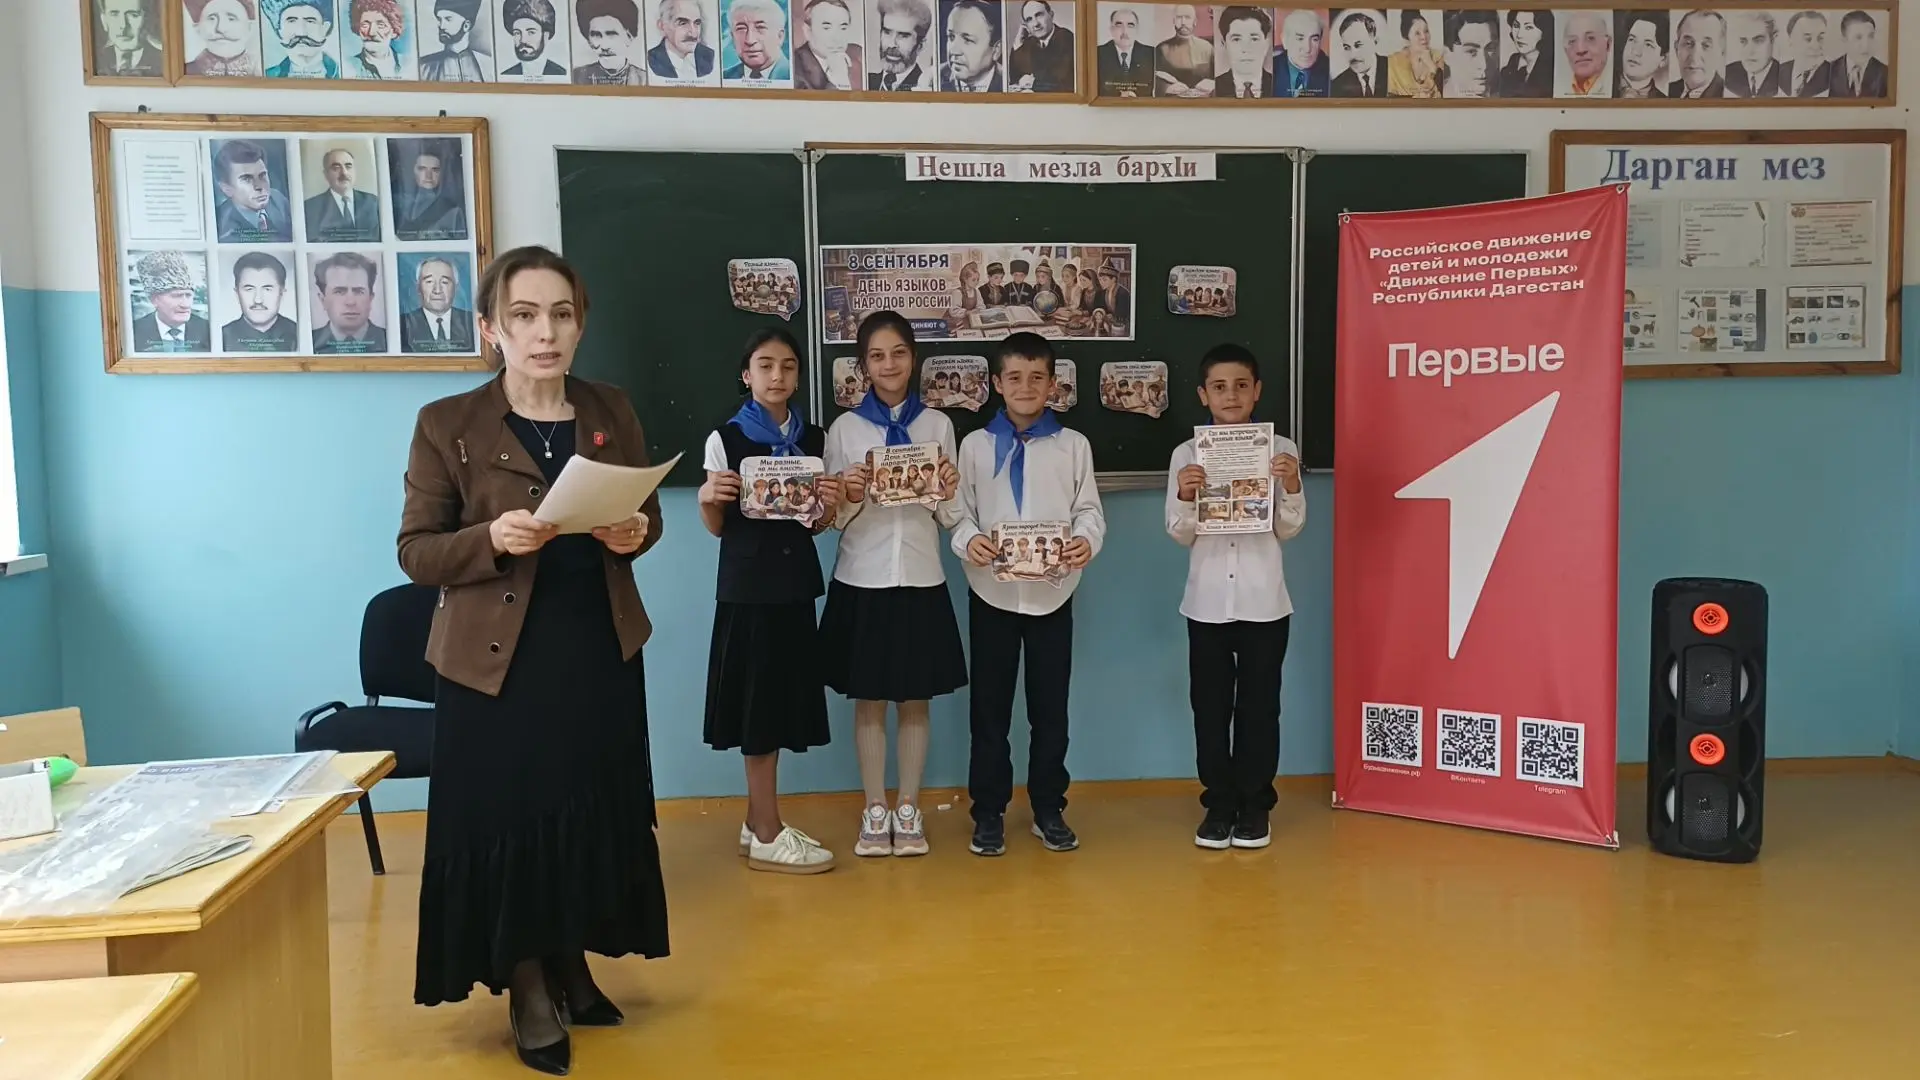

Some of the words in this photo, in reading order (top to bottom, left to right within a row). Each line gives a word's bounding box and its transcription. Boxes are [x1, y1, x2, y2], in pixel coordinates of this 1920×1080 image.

[916, 155, 1006, 178] Нешла
[1029, 159, 1102, 178] мезла
[1601, 149, 1737, 189] Дарган
[1763, 156, 1826, 181] мез
[1369, 240, 1484, 259] Российское
[1487, 229, 1592, 250] движение
[849, 255, 858, 269] 8
[863, 254, 949, 269] СЕНТЯБРЯ
[1388, 257, 1443, 273] детей
[1448, 258, 1459, 268] и
[1463, 247, 1569, 267] молодежи
[858, 279, 891, 294] ДЕНЬ
[895, 279, 947, 292] ЯЗЫКОВ
[1379, 271, 1486, 290] «Движение
[1490, 264, 1578, 283] Первых»
[853, 296, 905, 309] НАРОДОВ
[908, 296, 952, 308] РОССИИ
[1372, 287, 1485, 304] Республики
[1489, 279, 1584, 298] Дагестан
[910, 321, 937, 329] ДИНЯЮТ
[1388, 341, 1565, 387] Первые
[1534, 784, 1567, 796] Telegram
